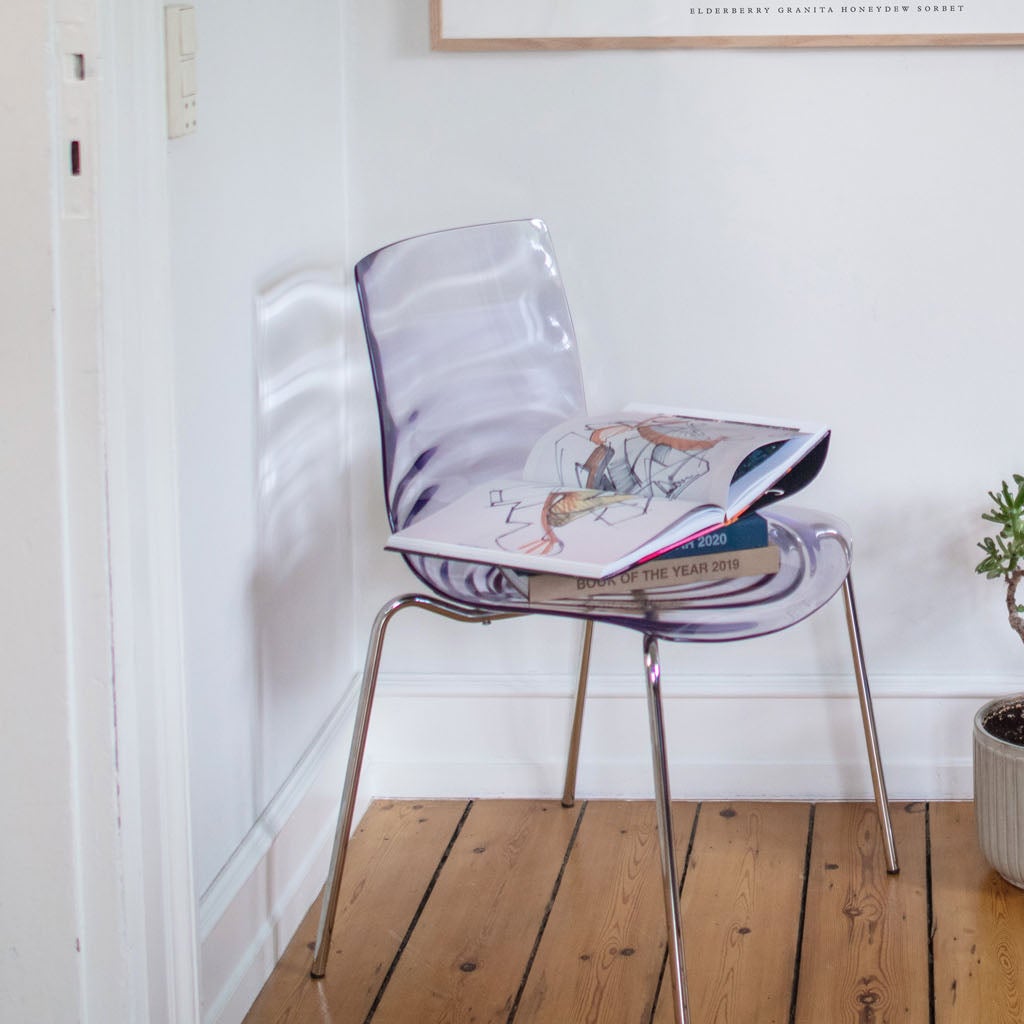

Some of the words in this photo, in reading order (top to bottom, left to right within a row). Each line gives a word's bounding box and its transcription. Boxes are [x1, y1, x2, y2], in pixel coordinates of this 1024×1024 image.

[689, 6, 771, 15] ELDERBERRY
[777, 6, 835, 14] GRANITA
[841, 5, 911, 14] HONEYDEW
[916, 4, 966, 13] SORBET
[697, 533, 727, 548] 2020
[620, 571, 640, 584] OF
[642, 567, 669, 581] THE
[672, 562, 708, 577] YEAR
[712, 559, 739, 572] 2019
